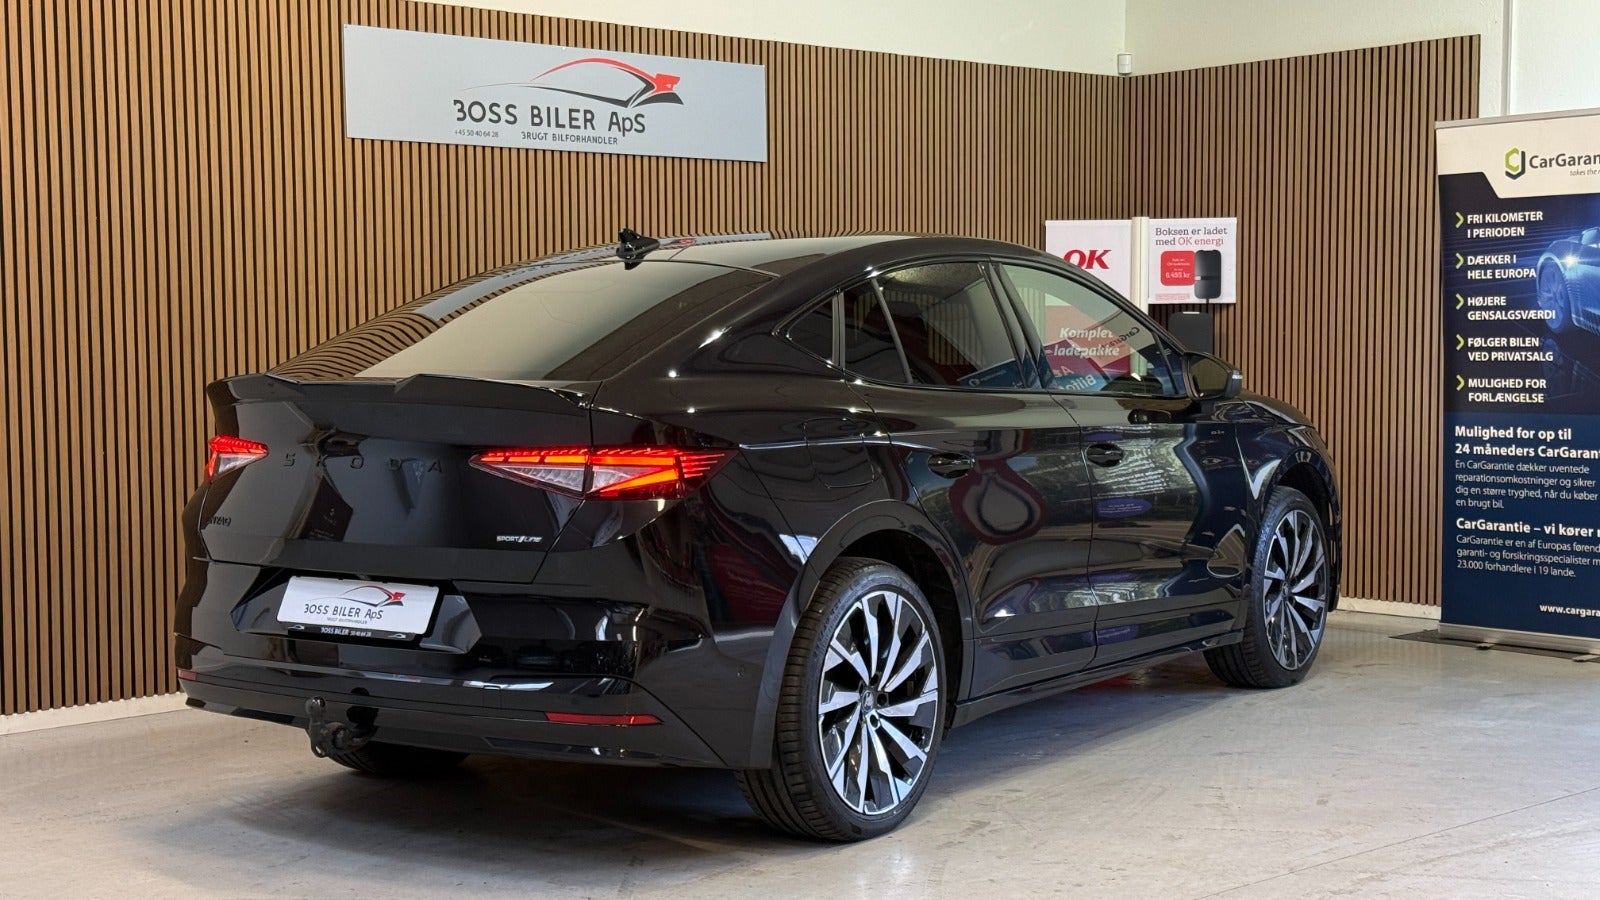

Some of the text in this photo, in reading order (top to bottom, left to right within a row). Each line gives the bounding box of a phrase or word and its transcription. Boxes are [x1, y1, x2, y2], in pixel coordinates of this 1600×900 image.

[530, 105, 596, 130] BILER
[607, 111, 646, 137] ApS
[454, 128, 466, 136] +45
[552, 133, 618, 145] BILFORHANDLER
[1467, 210, 1544, 224] FRI KILOMETER
[1155, 226, 1228, 236] Boksen er ladet
[1467, 226, 1525, 239] I PERIODEN
[1155, 236, 1224, 247] med OK energi
[1063, 249, 1112, 270] OK
[1467, 254, 1517, 266] DÆKKER I
[1467, 268, 1537, 280] HELE EUROPA
[1467, 296, 1507, 307] HØJERE
[1467, 310, 1556, 321] GENSALGSVÆRDI
[1467, 337, 1540, 348] FØLGER BILEN
[1468, 351, 1554, 362] VED PRIVATSALG
[1468, 378, 1547, 389] MULIGHED FOR
[1468, 392, 1545, 404] FORLÆNGELSE
[1455, 425, 1572, 442] Mulighed for op til
[1455, 443, 1600, 460] 24 måneders CarGaran
[1455, 460, 1590, 474] En CarGarantie dækker uventede
[1455, 474, 1596, 488] reparationsomkostninger og sikrer
[1455, 485, 1598, 501] dig en større tryghed, når du køber
[1468, 498, 1491, 510] brugt
[1456, 517, 1531, 533] CarGarantie
[1544, 523, 1556, 535] vi
[1559, 523, 1594, 537] kører
[1456, 534, 1504, 546] CarGarantie
[1505, 538, 1514, 547] er
[1515, 540, 1526, 548] en
[1528, 539, 1537, 548] af
[1537, 540, 1571, 552] Europas
[1456, 548, 1488, 558] garanti-
[1489, 551, 1501, 561] og
[1502, 549, 1591, 566] forsikringsspecialister
[1457, 559, 1483, 570] 23.000
[1484, 561, 1532, 574] forhandlere
[1538, 566, 1549, 575] 19
[1550, 566, 1577, 577] lande.
[332, 605, 361, 618] BILER
[364, 608, 384, 621] ApS
